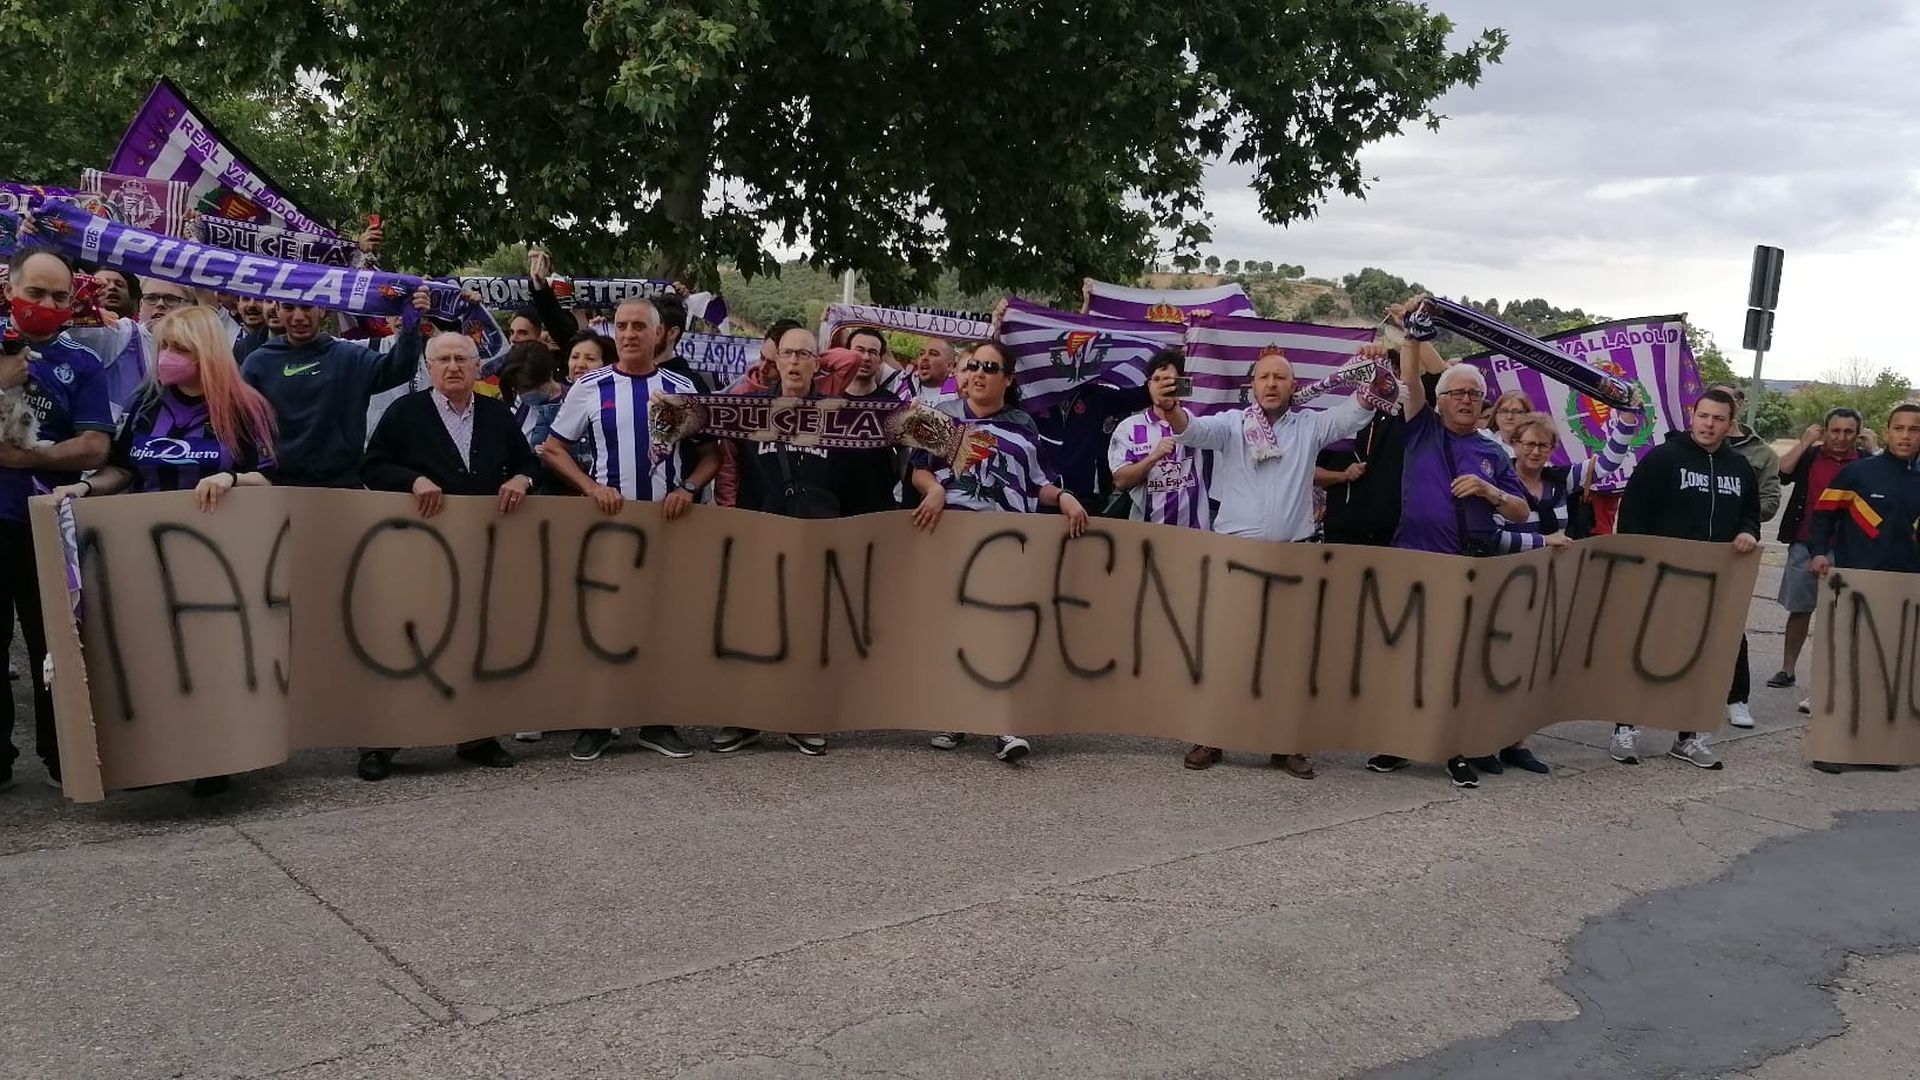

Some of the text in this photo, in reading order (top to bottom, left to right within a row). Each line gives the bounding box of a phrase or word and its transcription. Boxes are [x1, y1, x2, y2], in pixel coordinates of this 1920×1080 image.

[179, 117, 220, 166] REAL
[107, 229, 350, 305] PUCELA
[207, 223, 350, 268] PUCELA
[872, 307, 993, 338] VALLADOLI
[1556, 327, 1681, 358] VALLADOLID
[709, 405, 884, 439] PUCELA
[340, 515, 647, 700] QUE
[712, 535, 875, 668] UN
